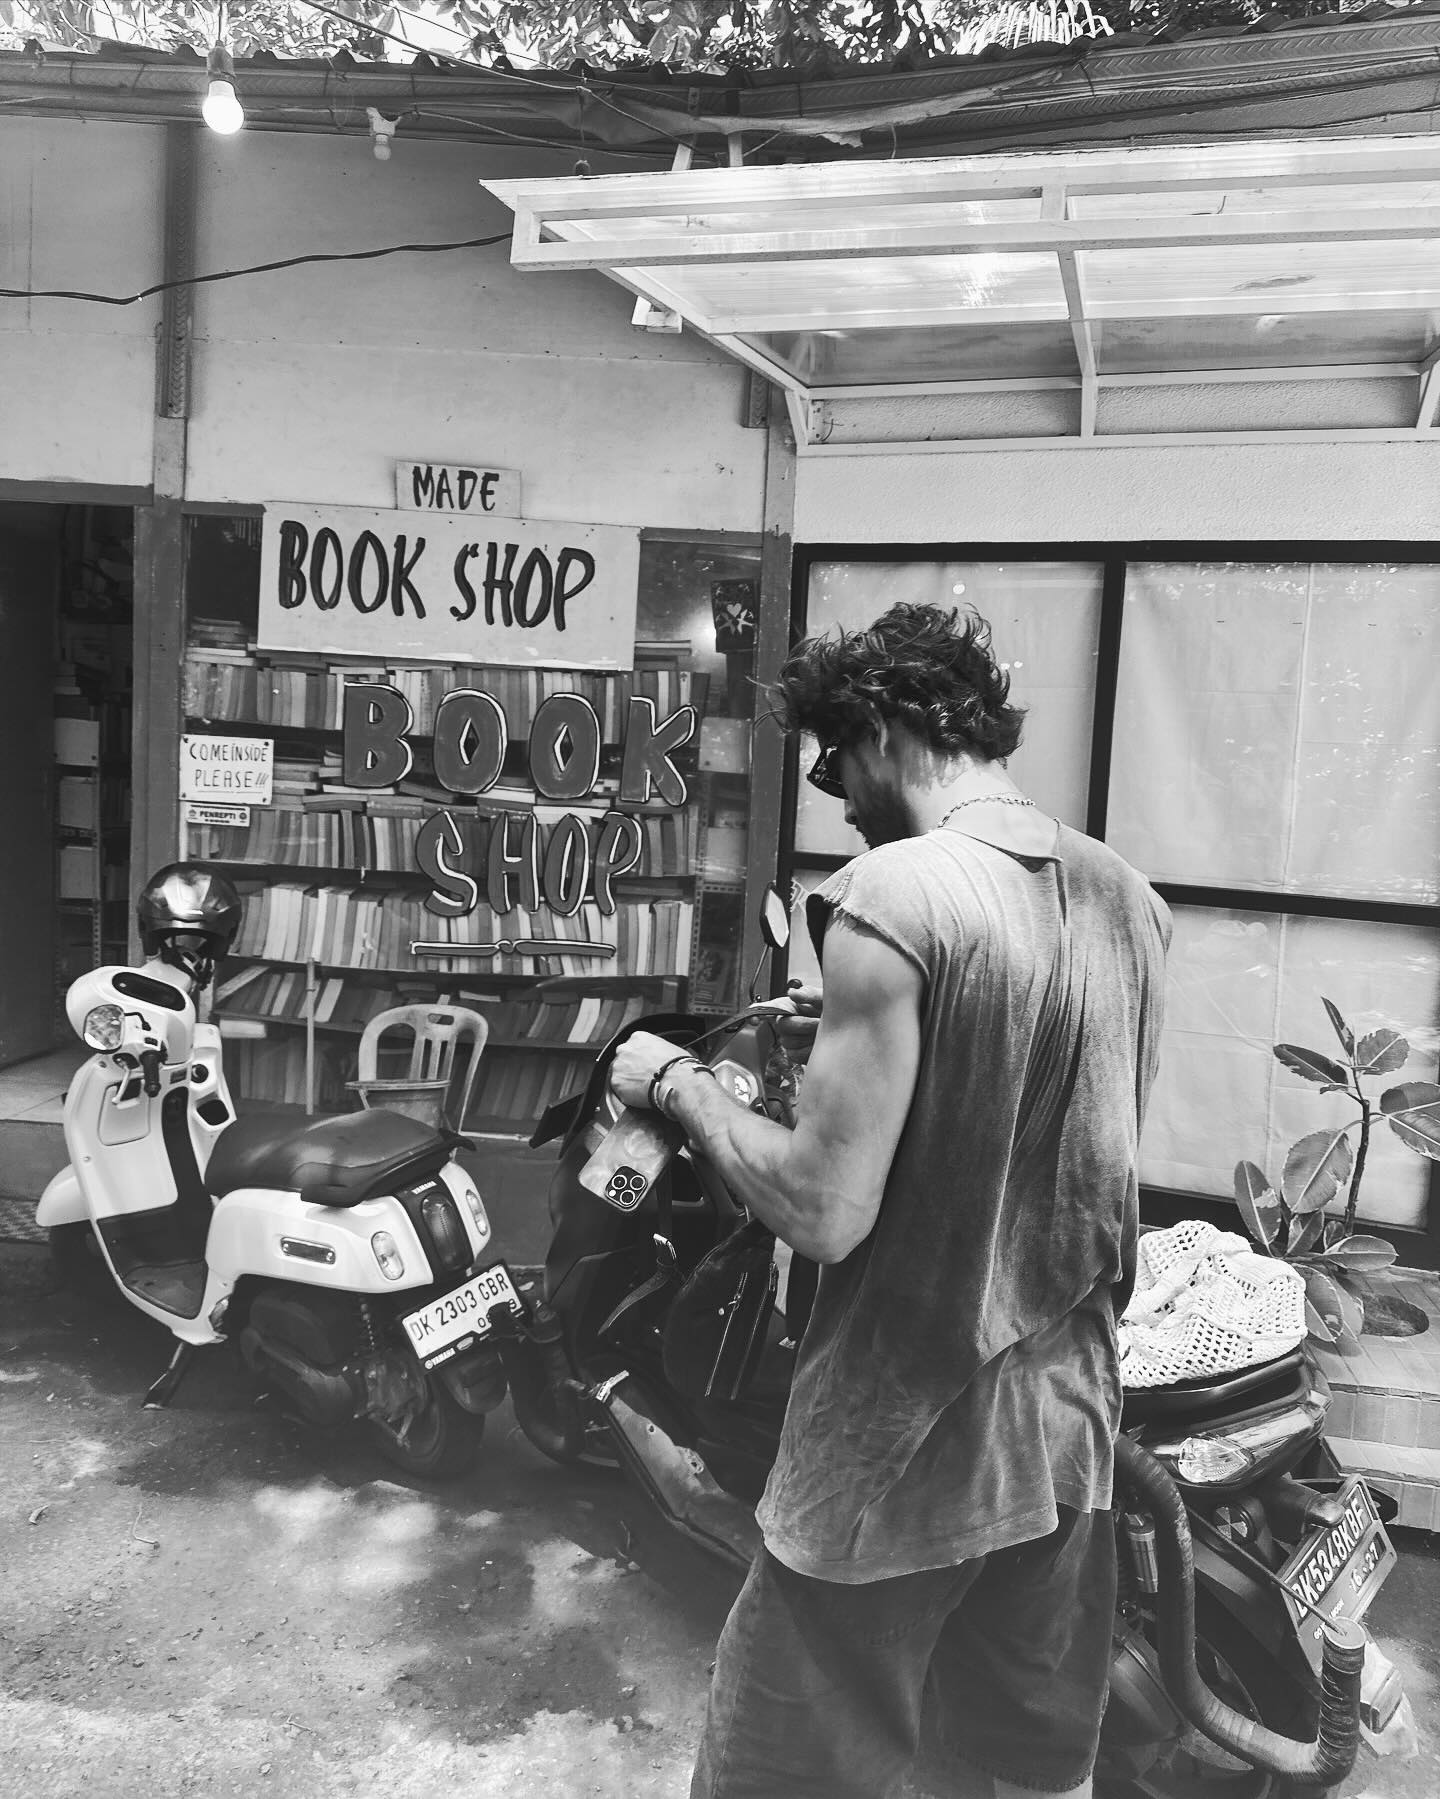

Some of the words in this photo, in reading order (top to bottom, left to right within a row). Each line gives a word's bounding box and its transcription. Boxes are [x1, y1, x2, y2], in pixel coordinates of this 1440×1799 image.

[413, 465, 500, 511] MADE
[279, 520, 426, 619] BOOK
[450, 542, 595, 632] SHOP
[343, 681, 697, 806] BOOK
[415, 810, 642, 917] SHOP
[409, 1314, 435, 1340] DK
[435, 1290, 477, 1326] 2303
[478, 1273, 509, 1301] CBR
